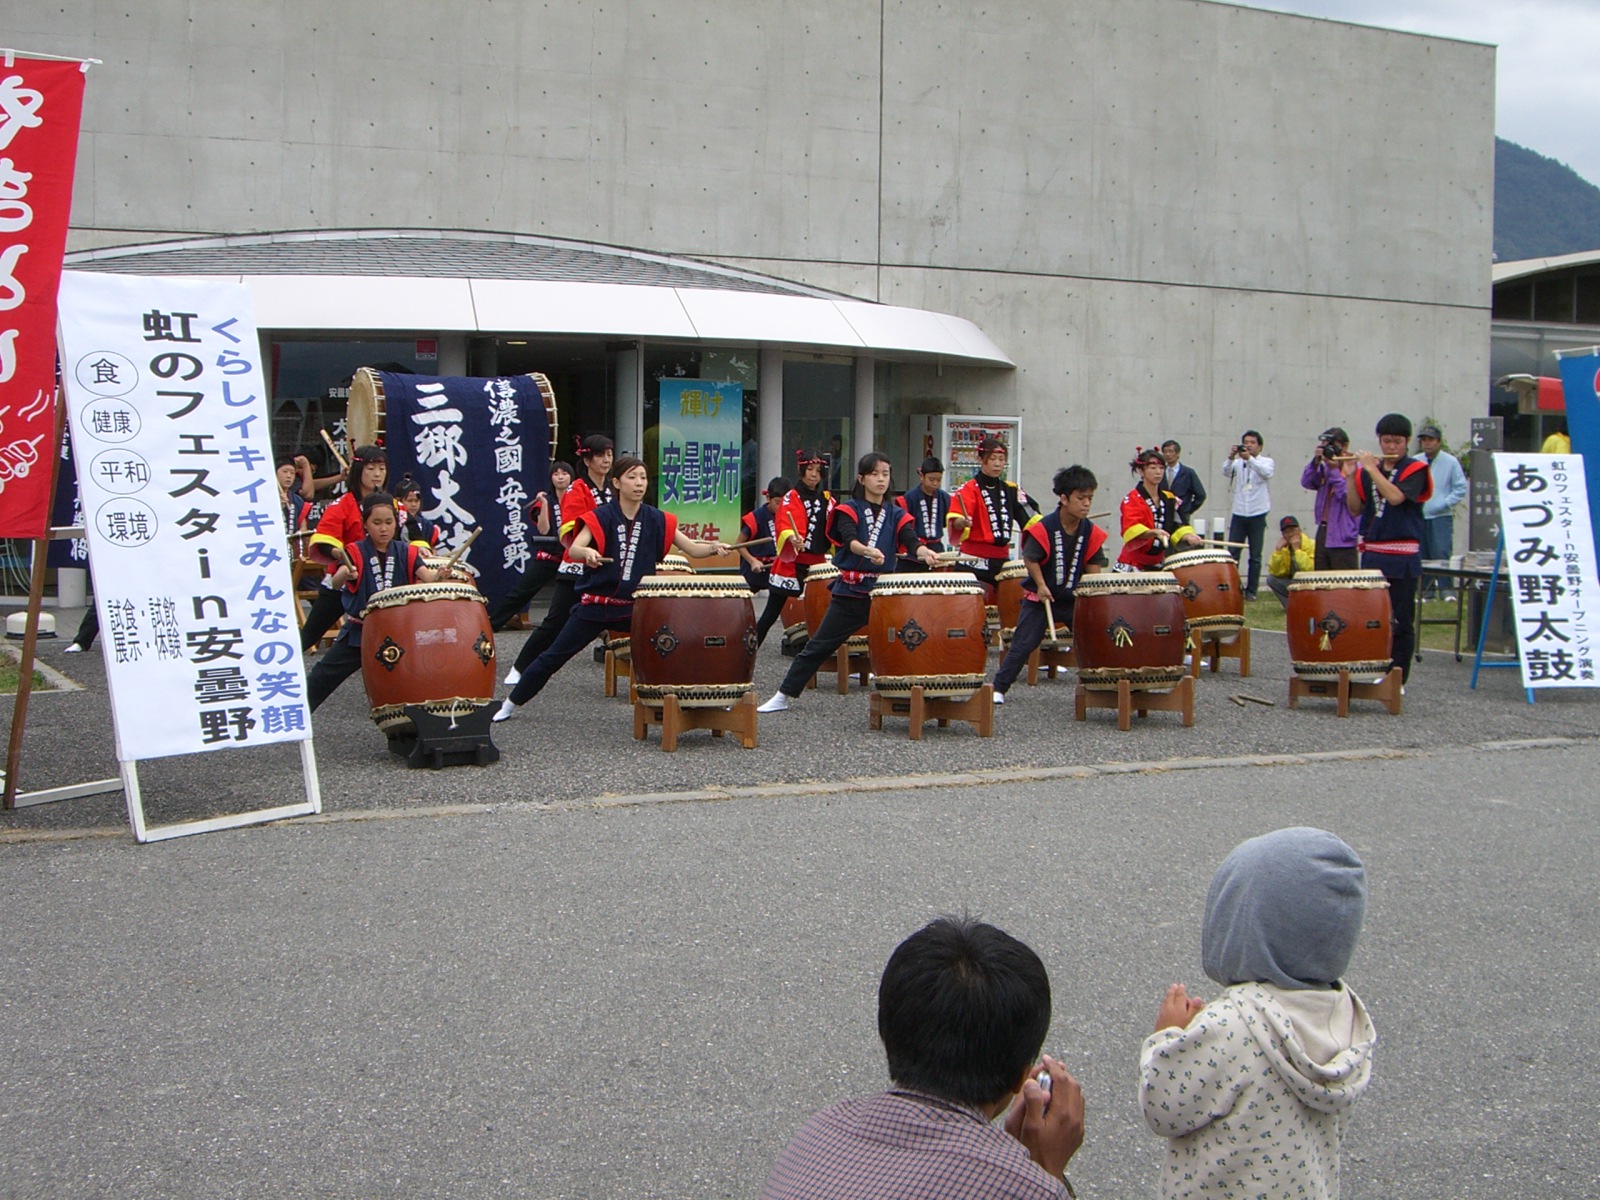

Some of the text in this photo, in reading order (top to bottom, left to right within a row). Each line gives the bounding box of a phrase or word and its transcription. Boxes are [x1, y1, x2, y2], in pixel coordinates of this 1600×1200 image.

[90, 358, 121, 385] 食
[680, 390, 723, 417] 輝け
[92, 409, 133, 434] 健康
[100, 460, 147, 484] 平和
[662, 441, 741, 505] 安曇野市
[106, 511, 150, 541] 環境
[143, 309, 255, 744] 虹のフェスタin安曇野
[211, 317, 306, 733] くらしイキイキみんなの笑顔
[1506, 464, 1577, 682] あづみ野太鼓
